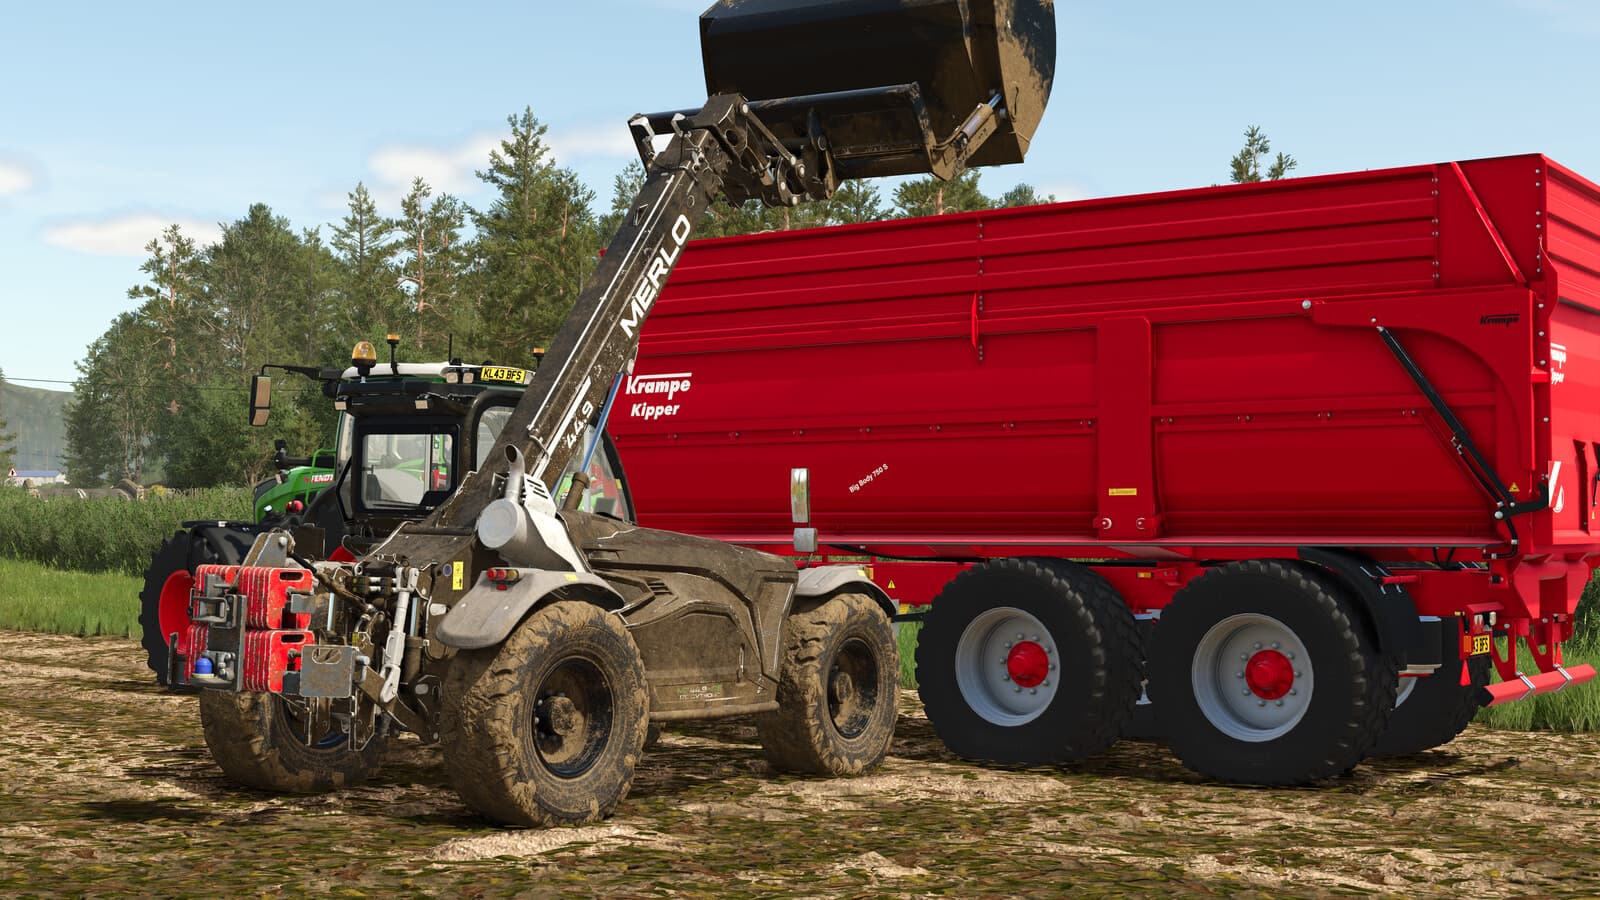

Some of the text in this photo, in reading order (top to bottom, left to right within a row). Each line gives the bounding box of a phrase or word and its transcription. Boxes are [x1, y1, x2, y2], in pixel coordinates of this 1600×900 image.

[619, 213, 691, 339] MERLO
[482, 367, 522, 381] KL43 BFS
[625, 372, 692, 400] Krampe
[566, 400, 594, 450] 44.9
[630, 402, 680, 421] Kipper
[311, 474, 334, 482] FENDT
[849, 484, 860, 493] Big
[858, 474, 873, 486] Body
[872, 466, 883, 477] 750
